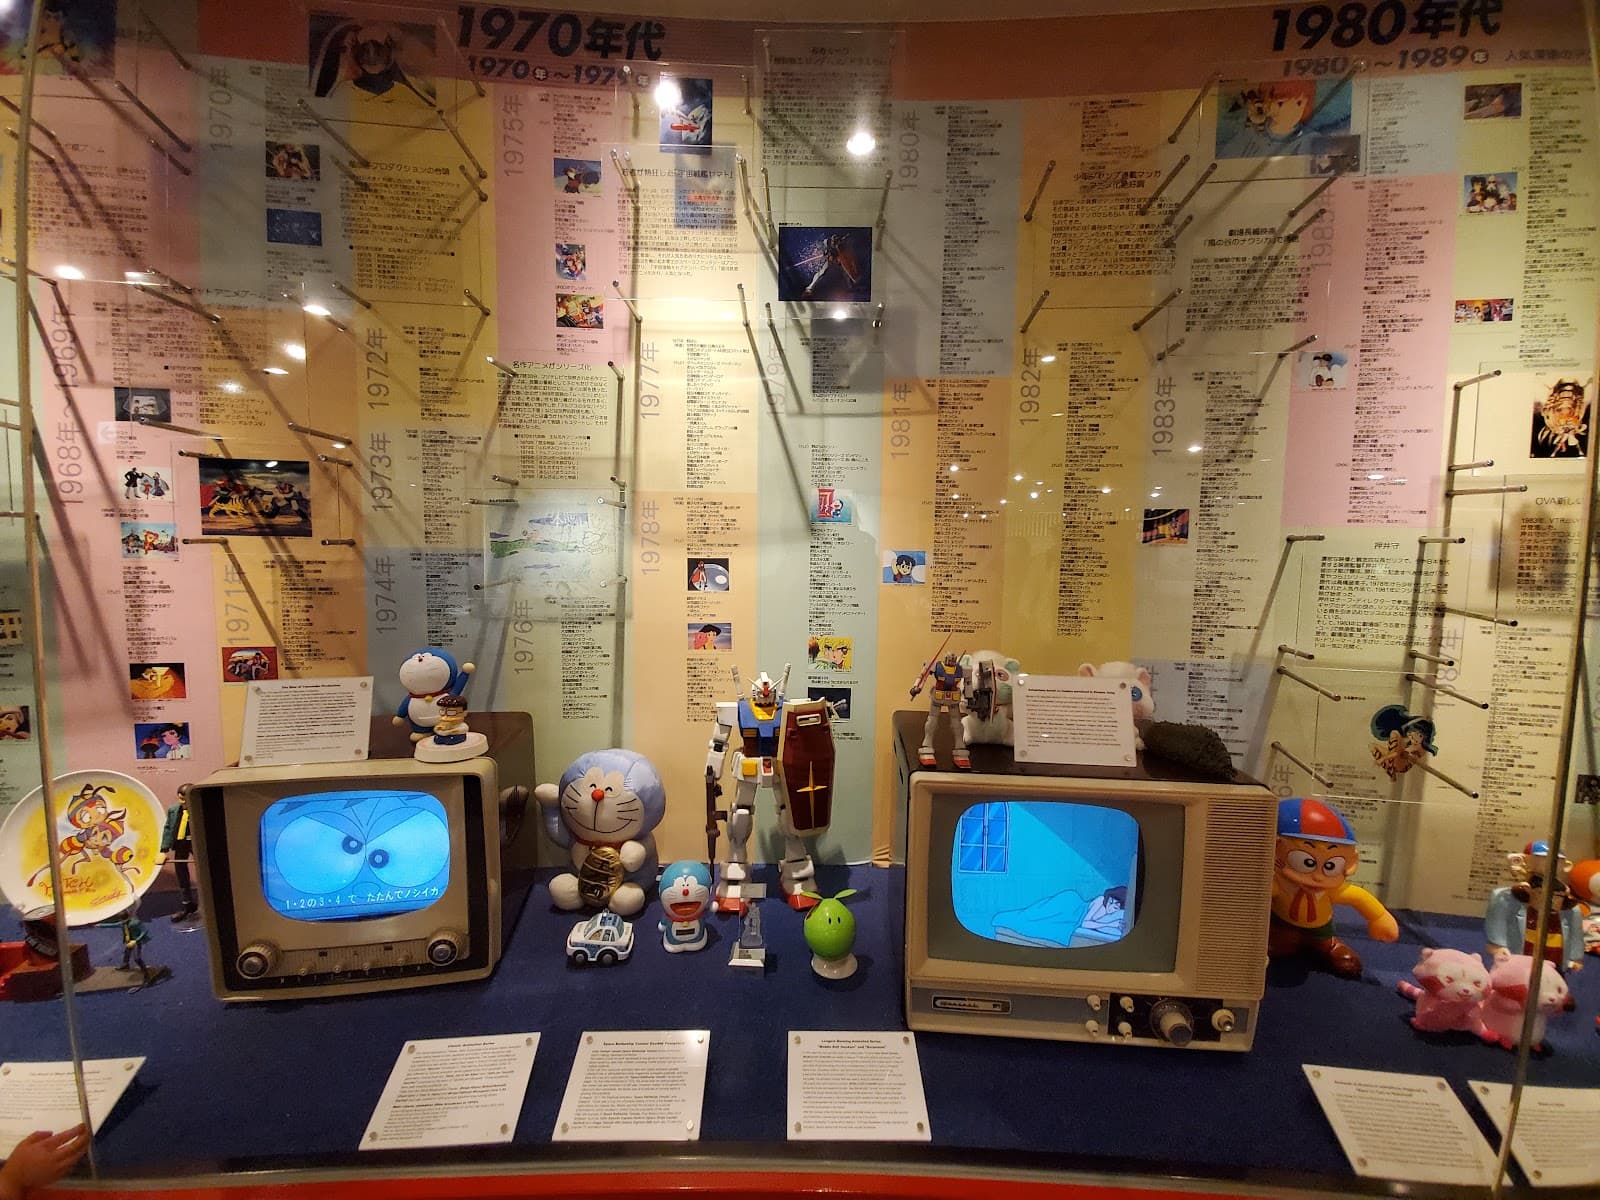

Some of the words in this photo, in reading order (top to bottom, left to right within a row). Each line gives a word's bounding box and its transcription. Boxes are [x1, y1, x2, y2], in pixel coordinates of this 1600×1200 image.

[457, 5, 666, 61] 1970年代
[1272, 0, 1502, 52] 1980年代
[207, 66, 233, 152] 1970年
[502, 94, 526, 178] 1975年
[898, 109, 921, 191] 1980年
[365, 327, 389, 410] 1972年
[640, 341, 660, 420] 1977年
[1018, 347, 1042, 426] 1982年
[890, 382, 911, 460] 1981年
[1152, 376, 1176, 457] 1983年
[369, 431, 393, 512] 1973年
[640, 499, 660, 576] 1978年
[224, 564, 250, 644] 1971年
[374, 556, 398, 635] 1974年
[513, 600, 534, 675] 1976年
